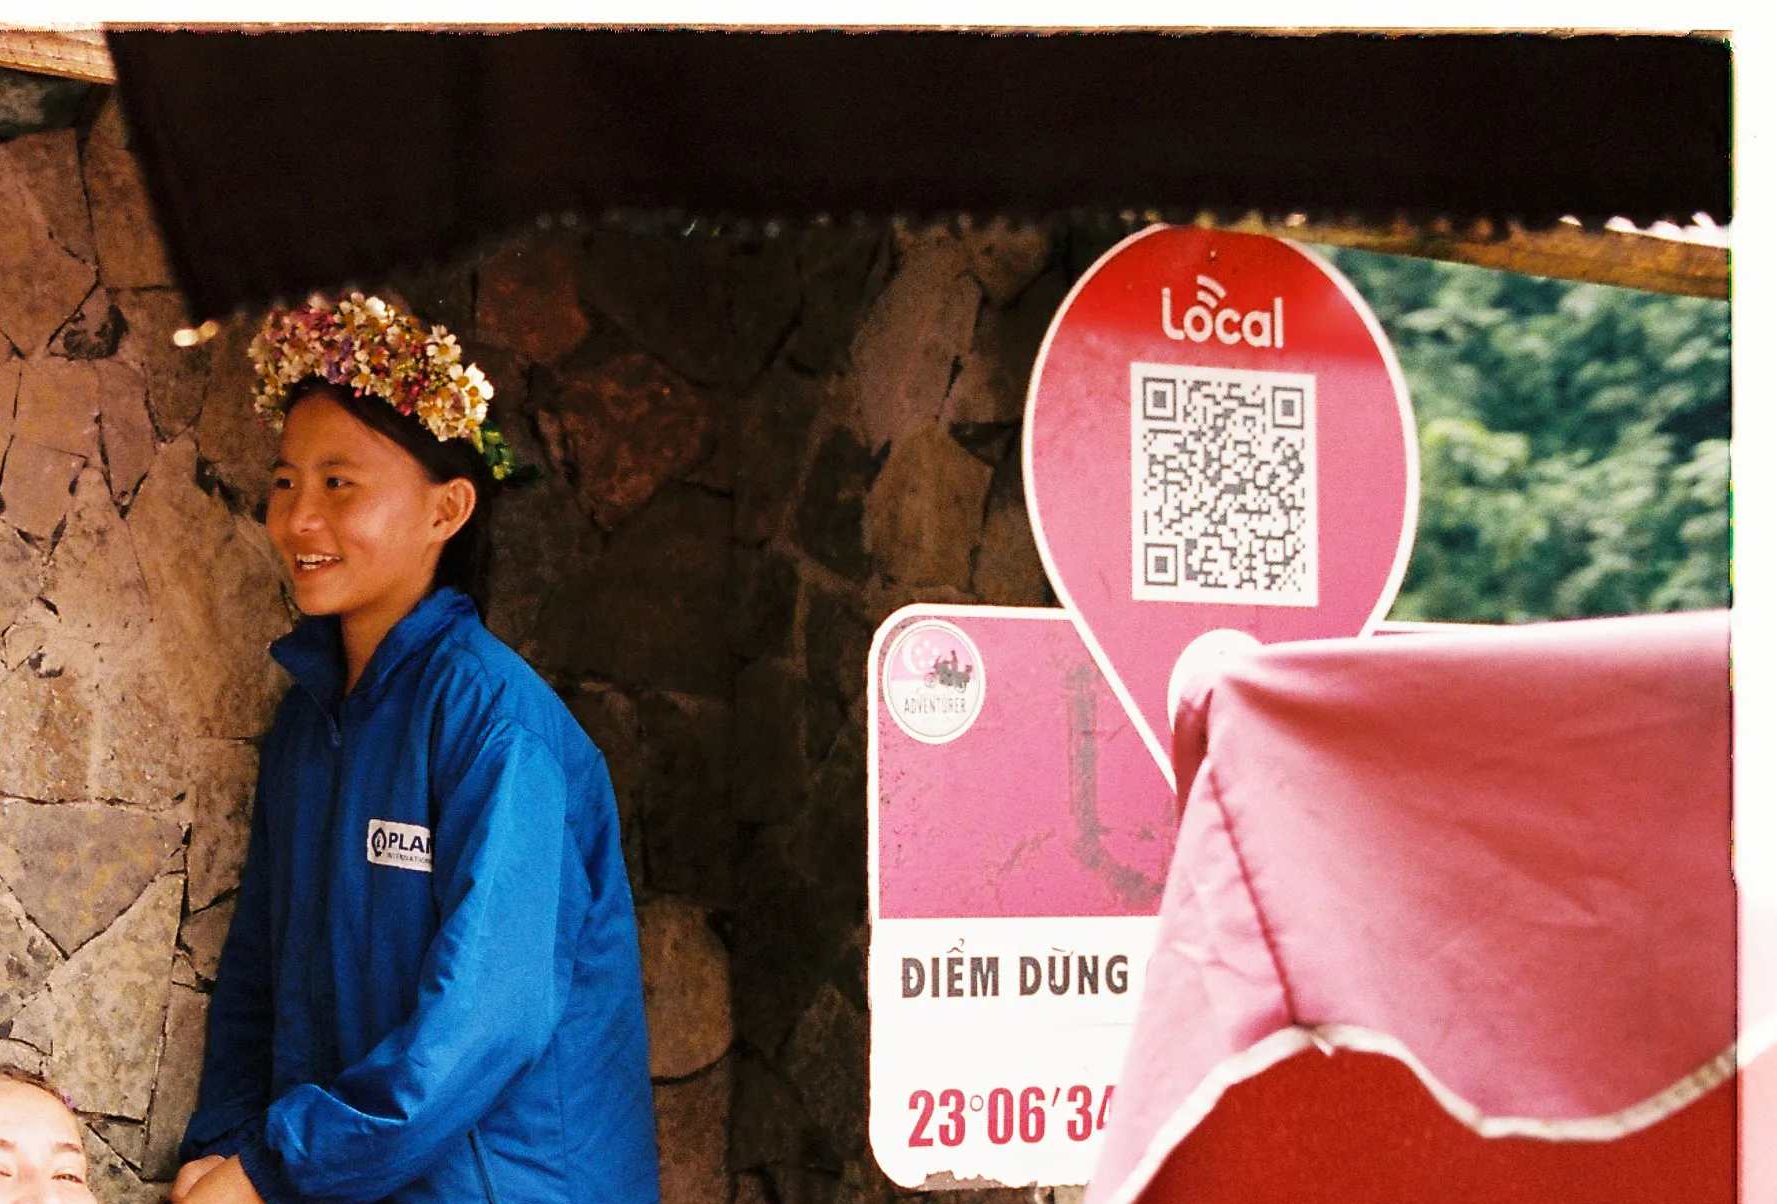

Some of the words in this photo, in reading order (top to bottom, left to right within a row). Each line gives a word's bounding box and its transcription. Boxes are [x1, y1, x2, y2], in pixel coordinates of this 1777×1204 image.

[1161, 286, 1284, 349] Local
[904, 697, 966, 714] ADVENTURER
[901, 938, 999, 998] ĐIỂM
